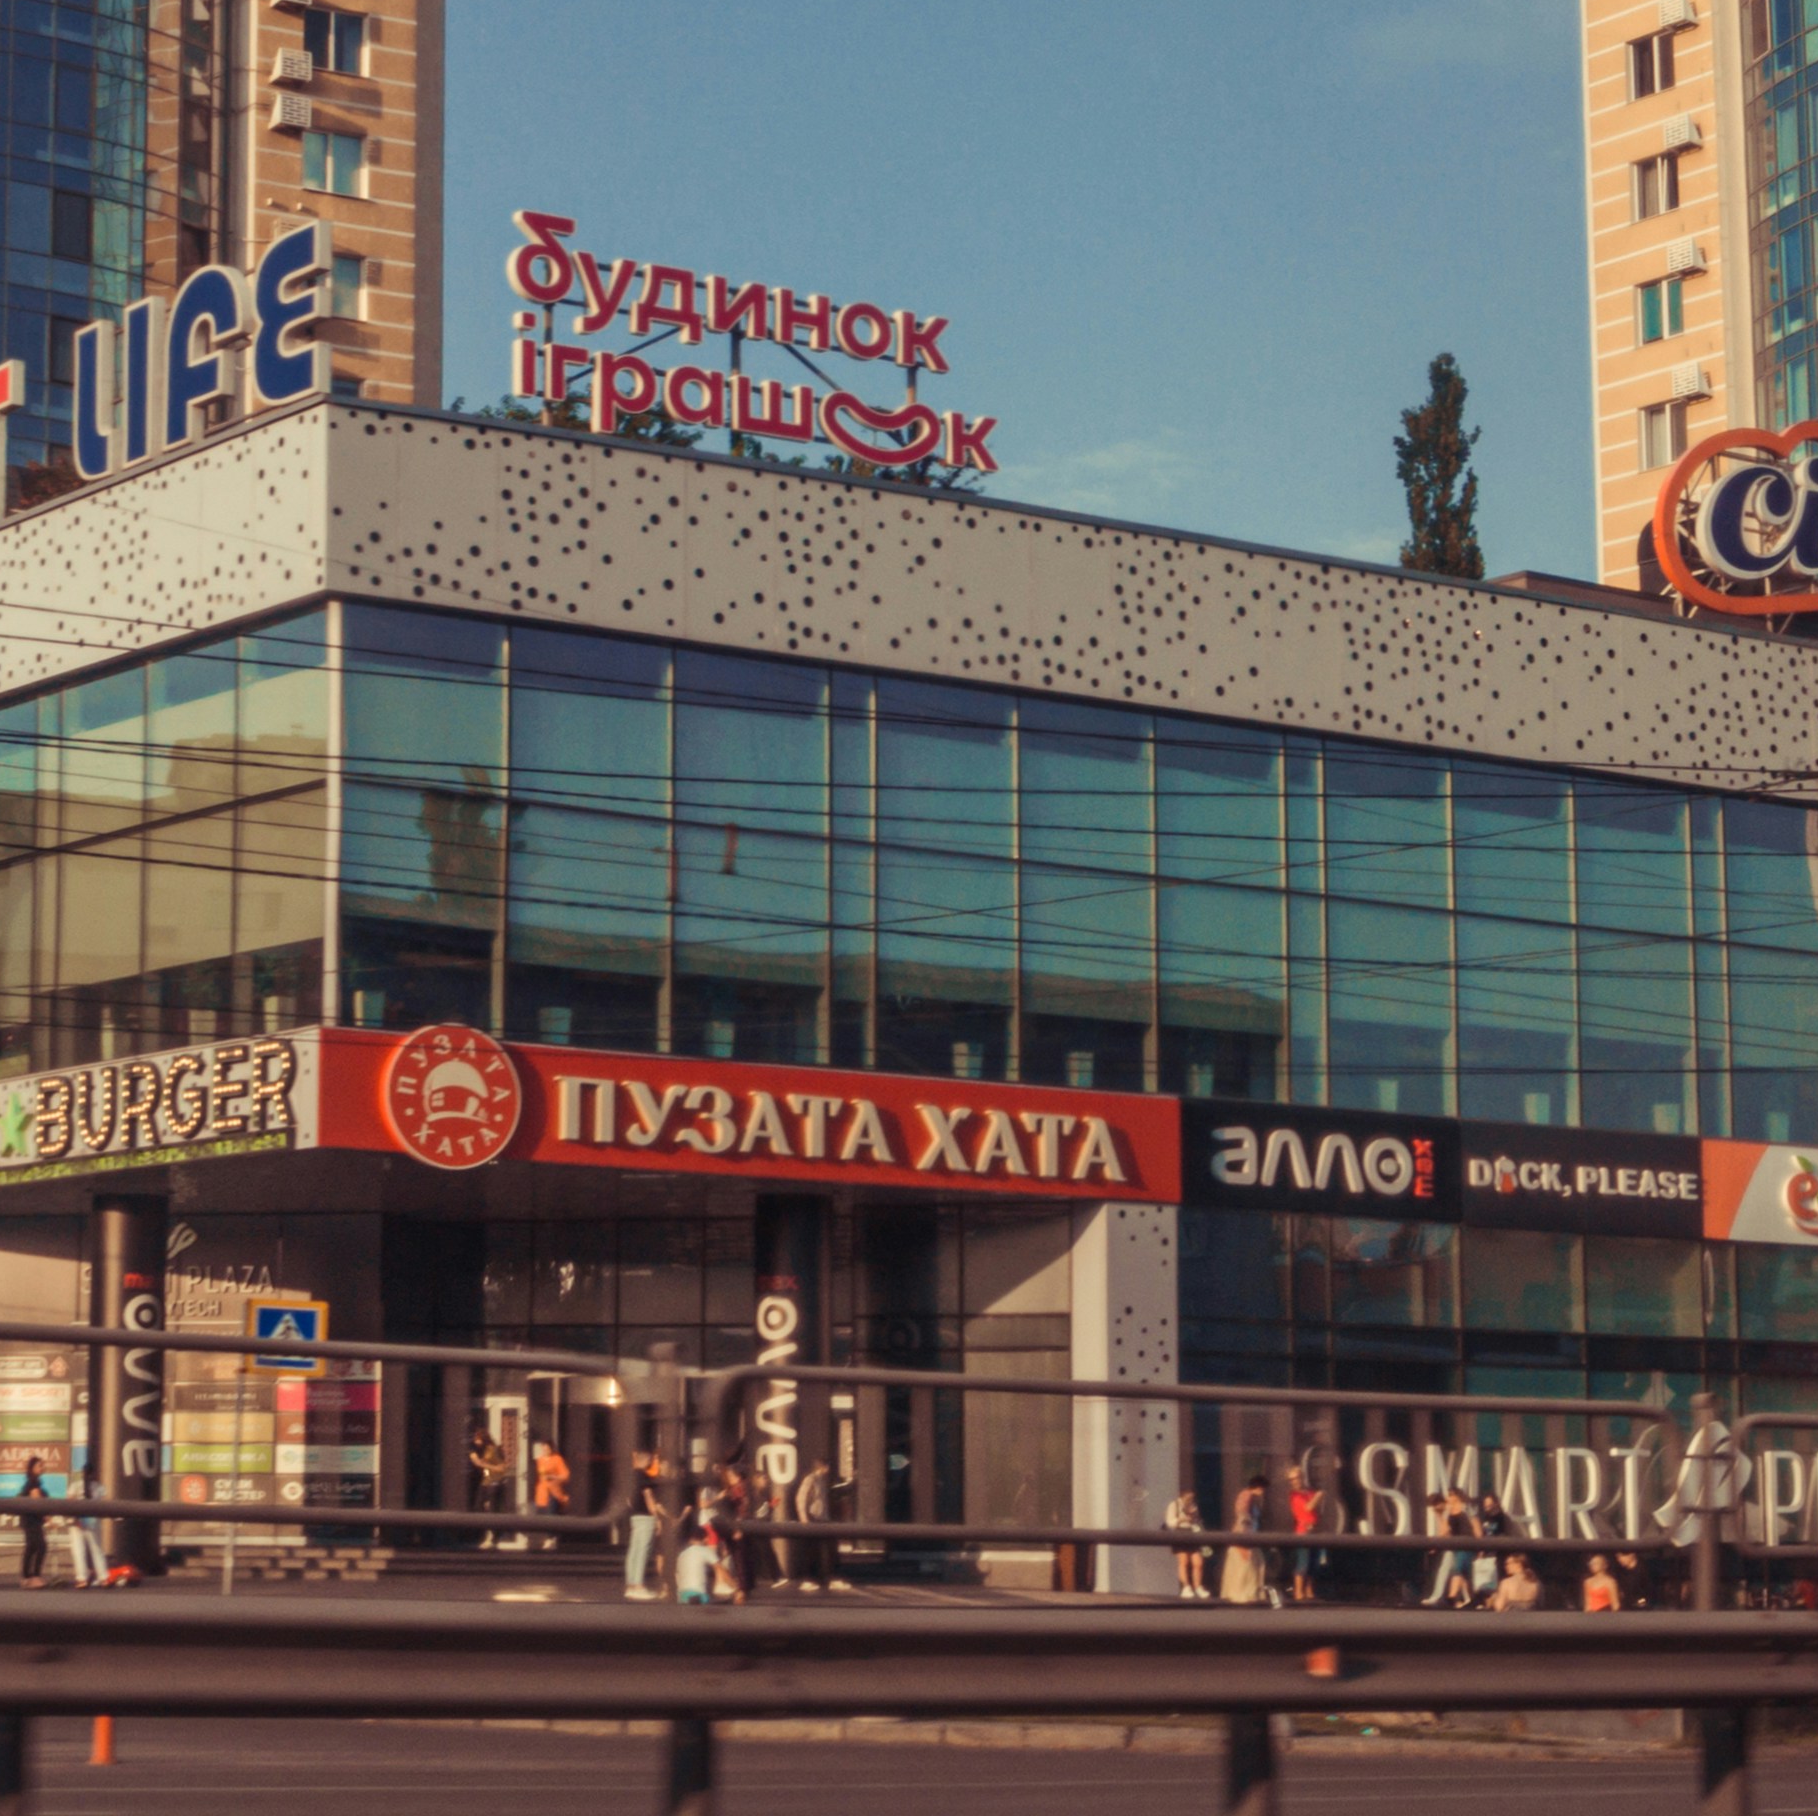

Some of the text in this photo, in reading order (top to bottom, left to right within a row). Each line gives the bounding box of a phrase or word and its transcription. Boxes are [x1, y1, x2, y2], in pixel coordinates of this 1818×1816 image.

[507, 210, 949, 373] будинок
[74, 220, 333, 481] LIFE
[512, 311, 999, 472] іграшок
[35, 1038, 298, 1159] BURGER
[396, 1034, 512, 1103] ПУЗАТА
[411, 1122, 500, 1157] ХАТА
[553, 1075, 1127, 1182] ПУЗАТА ХАТА
[1577, 1165, 1699, 1201] PLEASE
[166, 1300, 222, 1318] YTECH
[188, 1265, 275, 1294] PLAZA
[1357, 1440, 1654, 1542] SMART
